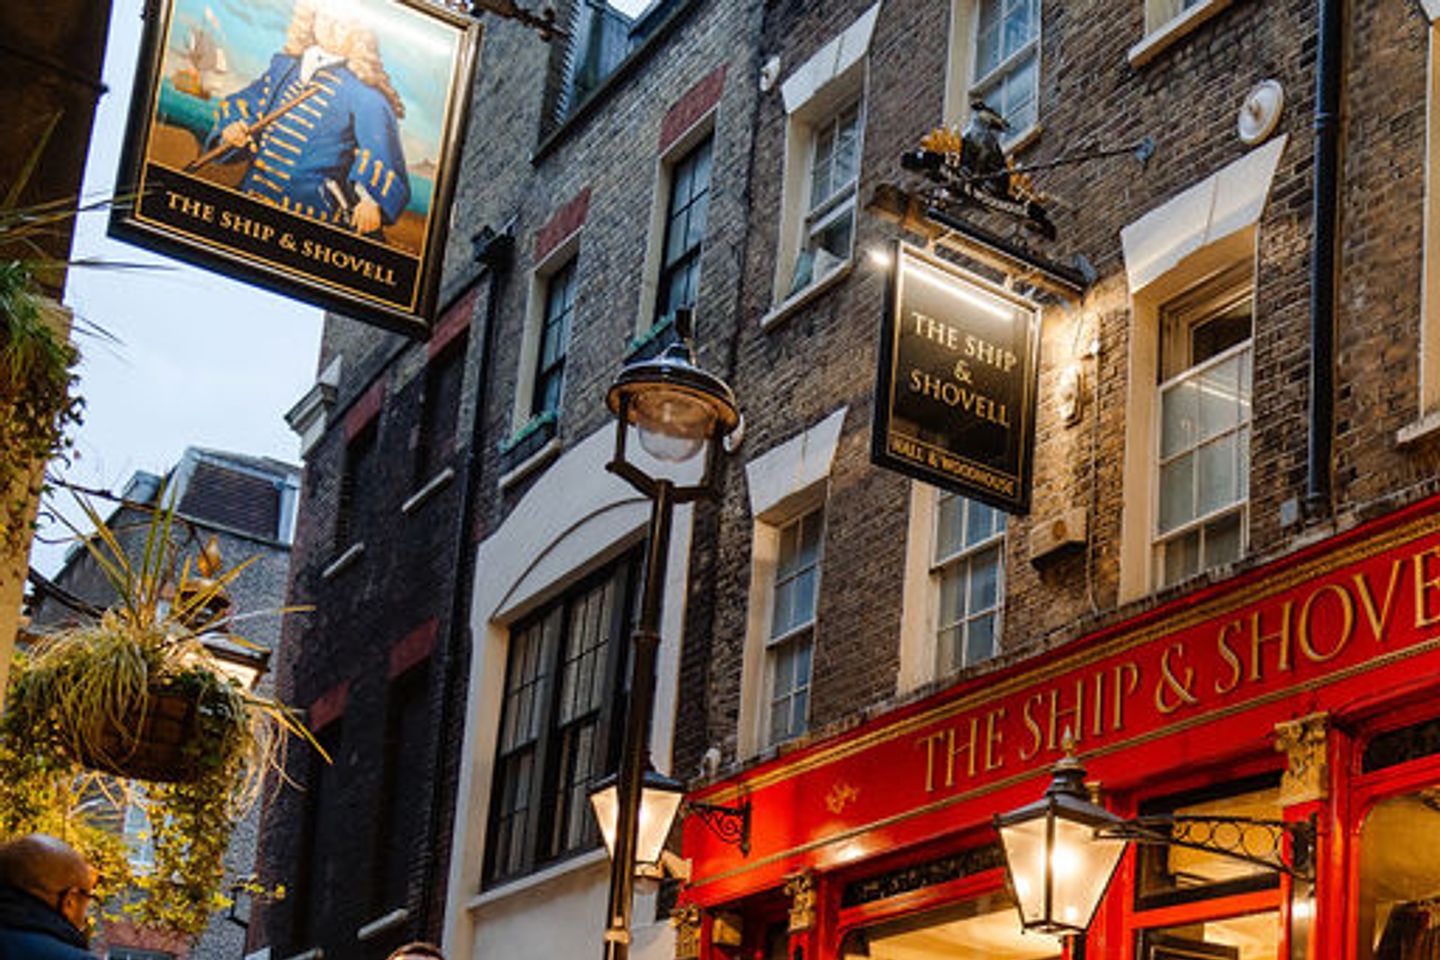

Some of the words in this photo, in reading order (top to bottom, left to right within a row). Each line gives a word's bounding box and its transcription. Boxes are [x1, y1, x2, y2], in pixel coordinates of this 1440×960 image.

[165, 190, 215, 222] THE
[219, 210, 275, 243] SHIP
[278, 232, 298, 252] &
[301, 240, 397, 286] SHOVELL
[911, 312, 959, 350] THE
[964, 334, 1017, 373] SHIP
[953, 359, 972, 384] &
[909, 368, 1011, 428] SHOVELL
[916, 707, 1006, 792] THE
[1019, 661, 1139, 761] SHIP
[1154, 642, 1200, 714] &
